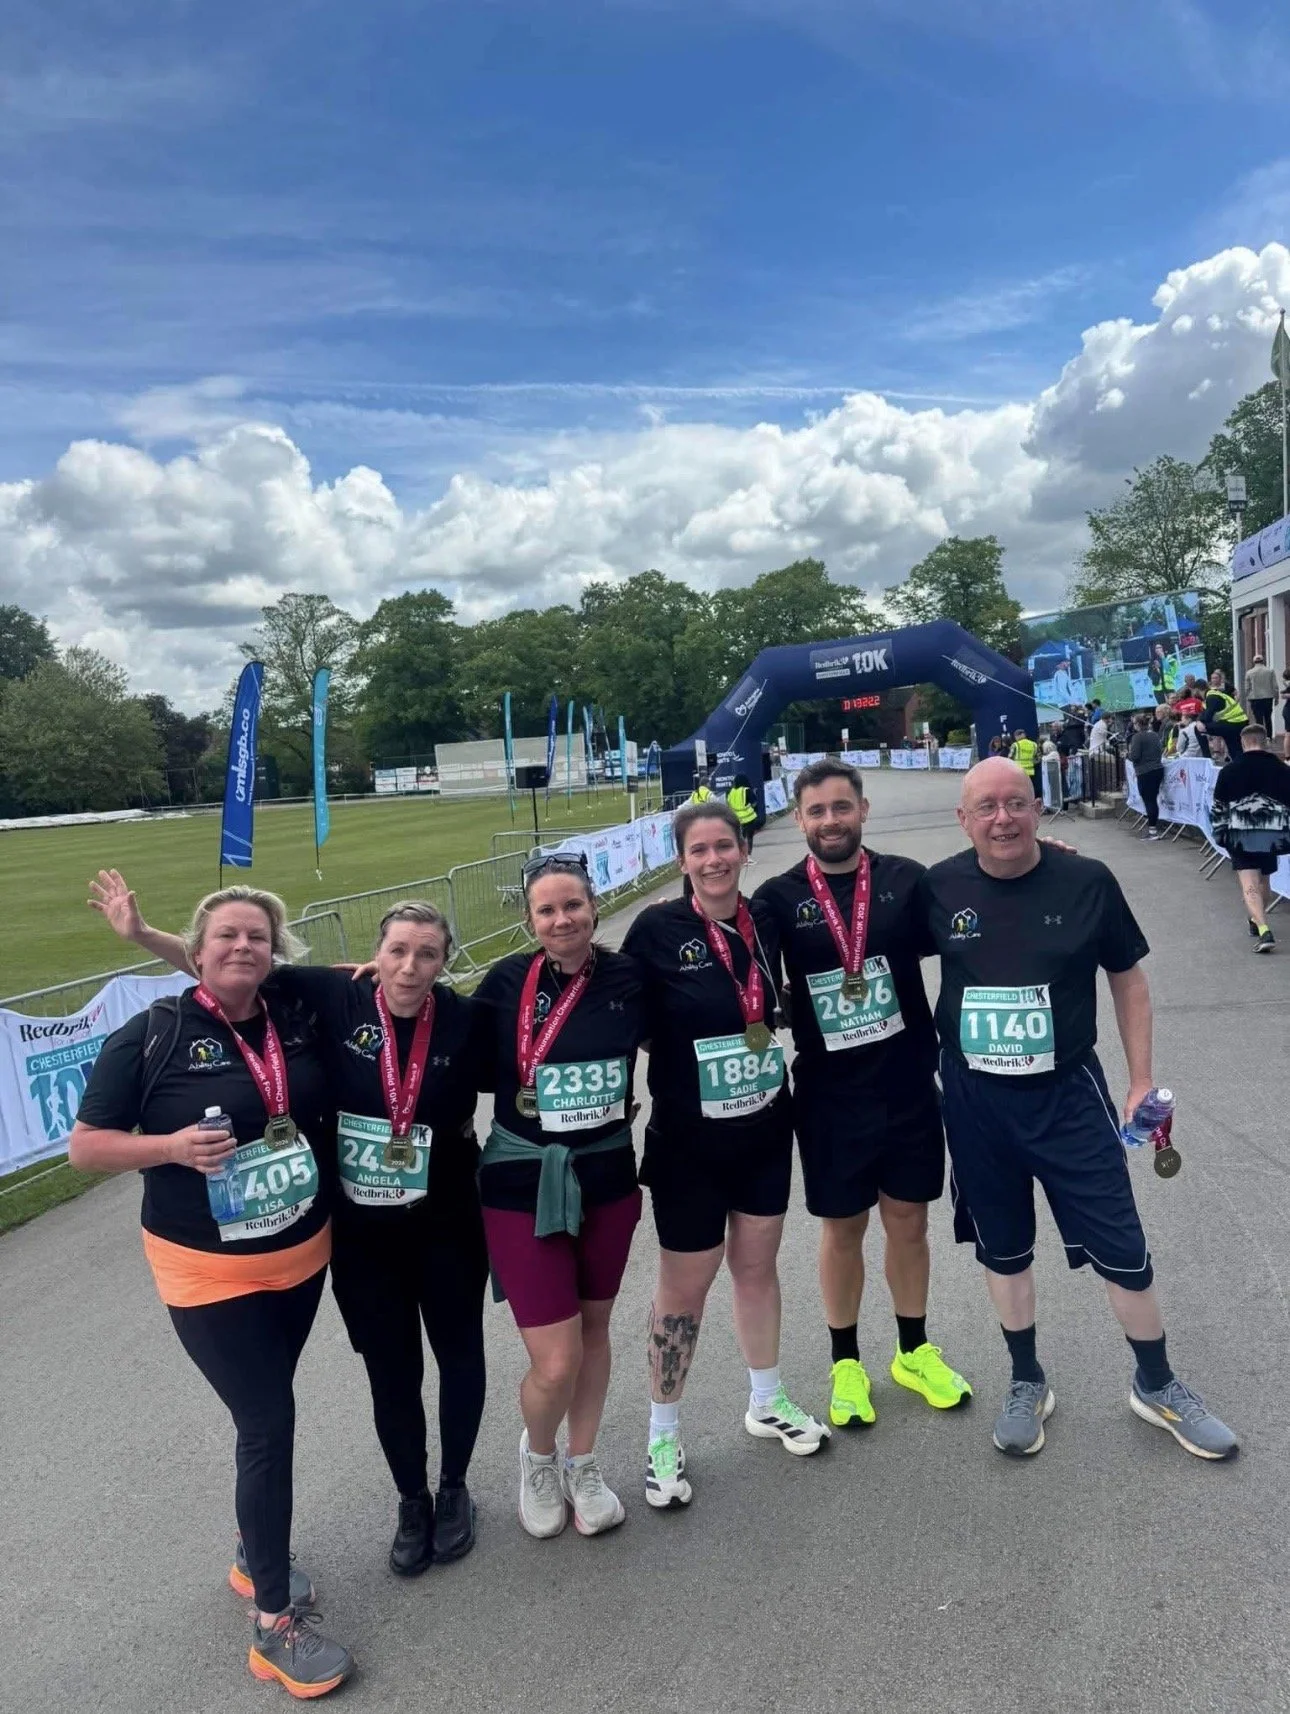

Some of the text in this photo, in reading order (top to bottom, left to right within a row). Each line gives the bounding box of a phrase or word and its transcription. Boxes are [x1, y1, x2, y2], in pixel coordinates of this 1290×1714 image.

[852, 648, 888, 674] 10K
[856, 921, 864, 934] 10K
[966, 986, 1046, 1004] CHESTERFIELD 10K
[840, 1010, 882, 1029] NATHAN
[968, 1011, 1048, 1040] 1140
[20, 1018, 93, 1043] Redbrik
[527, 1057, 539, 1086] Redbrik
[535, 1017, 560, 1056] Foundation
[557, 974, 585, 1018] Chesterfield
[843, 1023, 878, 1042] Redbrik
[700, 1038, 744, 1051] CHESTERFIE
[988, 1043, 1023, 1053] DAVID
[188, 1061, 213, 1071] Ability
[248, 1053, 266, 1081] Redbrik
[384, 1036, 395, 1086] Chesterfield
[706, 1051, 779, 1087] 1884
[982, 1057, 1022, 1068] Redbrik
[269, 1053, 284, 1102] Chesterfield
[542, 1060, 621, 1095] 2335
[389, 1087, 397, 1103] 10K
[730, 1082, 758, 1097] SADIE
[552, 1092, 616, 1109] CHARLOTTE
[722, 1097, 758, 1111] Redbrik
[343, 1118, 392, 1132] CHESTERFIE
[561, 1109, 598, 1123] Redbrik
[343, 1138, 424, 1174] 240
[244, 1155, 312, 1201] 405
[356, 1173, 401, 1186] ANGELA
[353, 1186, 394, 1199] Redbrik
[257, 1198, 285, 1215] LISA
[244, 1212, 290, 1230] Redbrik
